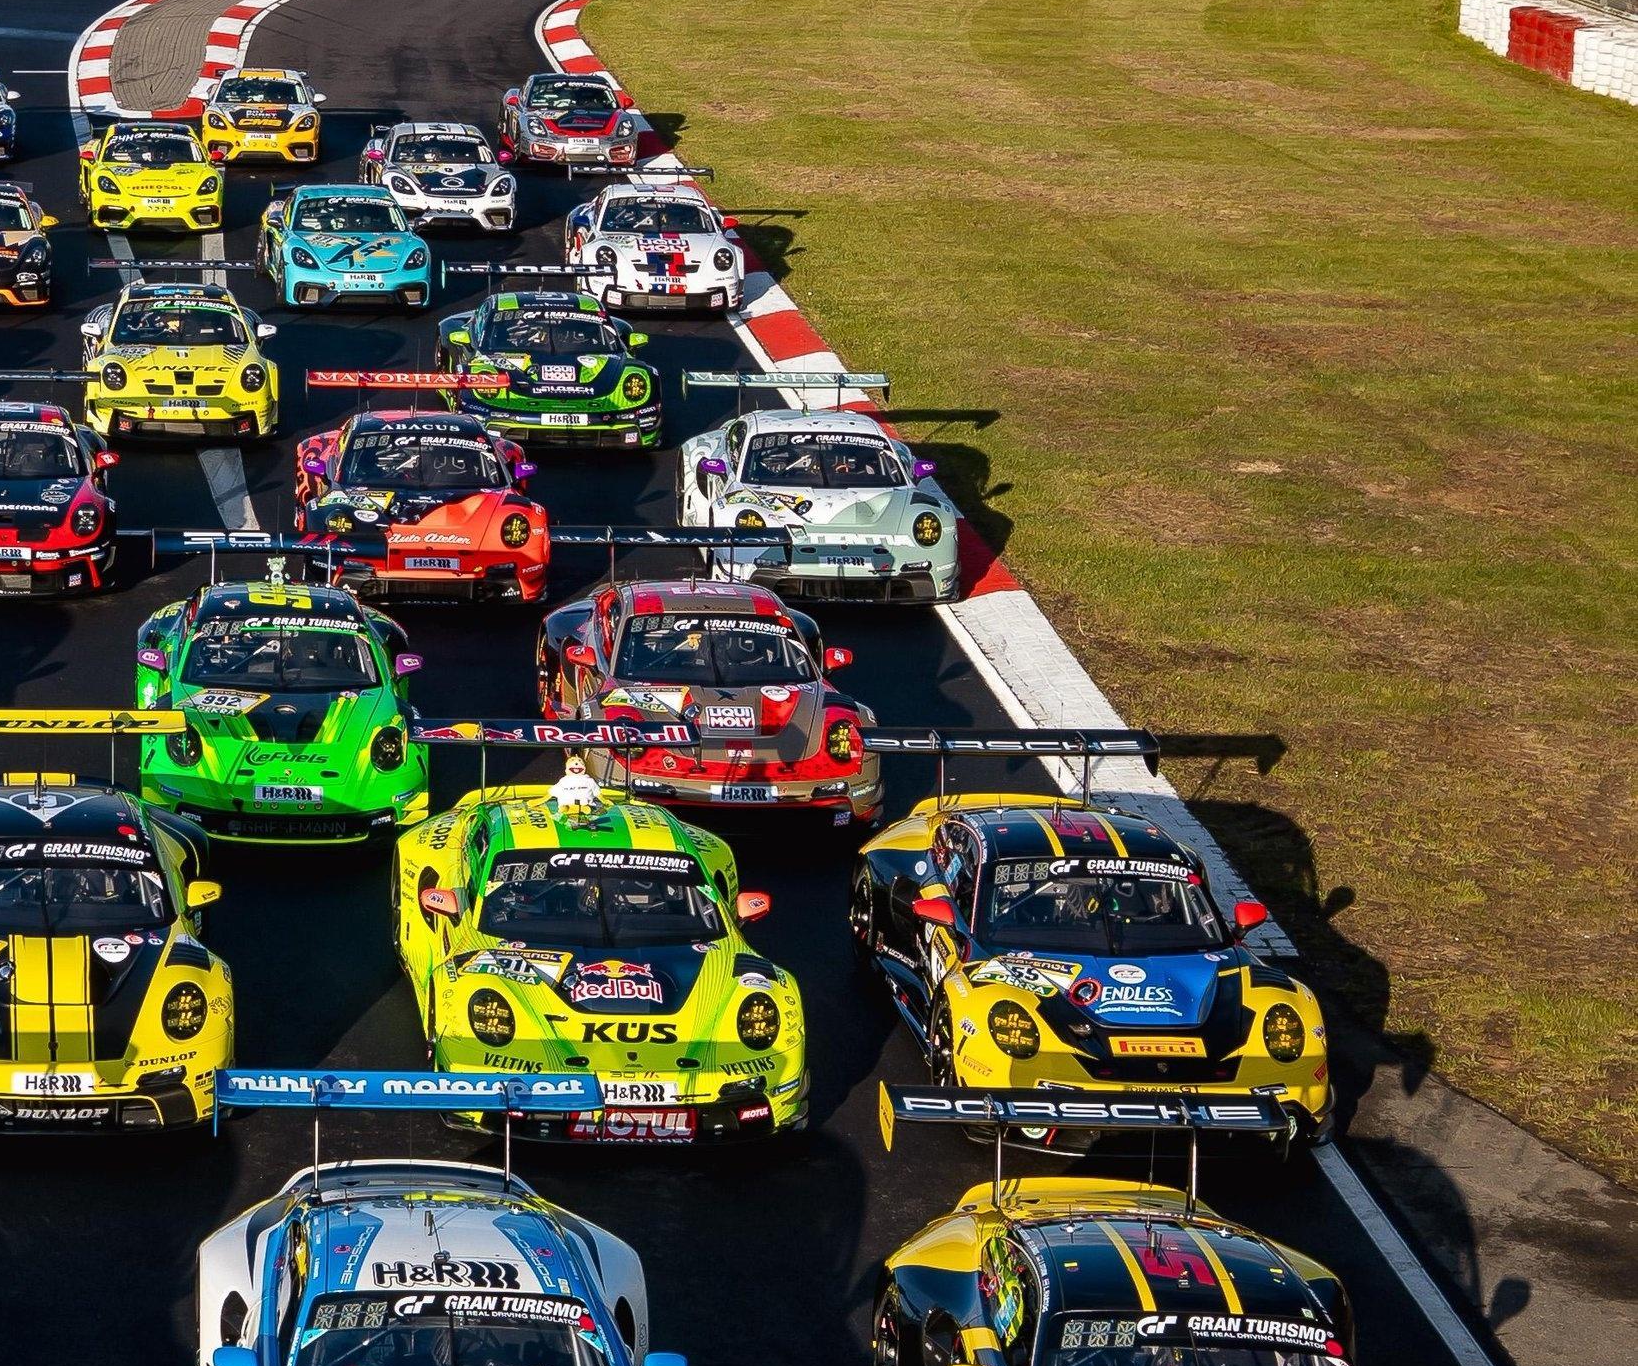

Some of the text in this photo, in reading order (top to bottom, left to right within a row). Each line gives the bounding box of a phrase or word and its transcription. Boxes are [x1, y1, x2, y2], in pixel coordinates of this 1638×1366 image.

[135, 365, 232, 373] FANATEC
[549, 414, 570, 423] H&R
[29, 423, 70, 435] TURISMO
[381, 423, 461, 432] ABACUS
[413, 558, 437, 568] H&R
[272, 617, 360, 631] GRAN TURISMO
[738, 620, 790, 635] TURISMO
[202, 695, 242, 707] 992
[708, 706, 752, 717] LIQUI
[709, 716, 754, 728] MOLY
[533, 724, 691, 743] Red Bull
[262, 786, 294, 800] H&R
[721, 786, 752, 801] H&R
[42, 843, 145, 860] GRAN TURISMO
[627, 854, 691, 870] TURISMO
[1086, 859, 1190, 877] GRAN TURISMO
[571, 979, 664, 1004] Red Bull
[1100, 986, 1174, 1002] ENDLESS
[580, 1021, 679, 1046] KÜS
[1119, 1039, 1198, 1054] PIRELLI
[138, 1051, 199, 1068] DUNLOP
[482, 1051, 544, 1074] VELTINS
[719, 1055, 777, 1077] VELTINS
[25, 1075, 60, 1091] H&R
[228, 1074, 585, 1098] mühlner motorsport
[603, 1083, 641, 1102] H&R
[15, 1107, 110, 1121] DUNLOP
[740, 1106, 771, 1120] MOTUL
[902, 1096, 1263, 1120] PORSCHE
[571, 1110, 694, 1136] MOTUL
[339, 1224, 375, 1286] PORSCHE
[504, 1227, 553, 1289] PORSCHE
[372, 1261, 474, 1289] H&R
[444, 1295, 499, 1312] GRAN
[501, 1295, 583, 1319] TURISMO
[490, 1312, 528, 1322] DRIVING
[529, 1314, 581, 1327] SIMULATOR
[1188, 1316, 1243, 1334] GRAN
[1245, 1316, 1329, 1343] TURISMO
[1210, 1332, 1234, 1340] REAL
[1235, 1333, 1274, 1344] DRIVING
[1275, 1335, 1328, 1351] SIMULATOR
